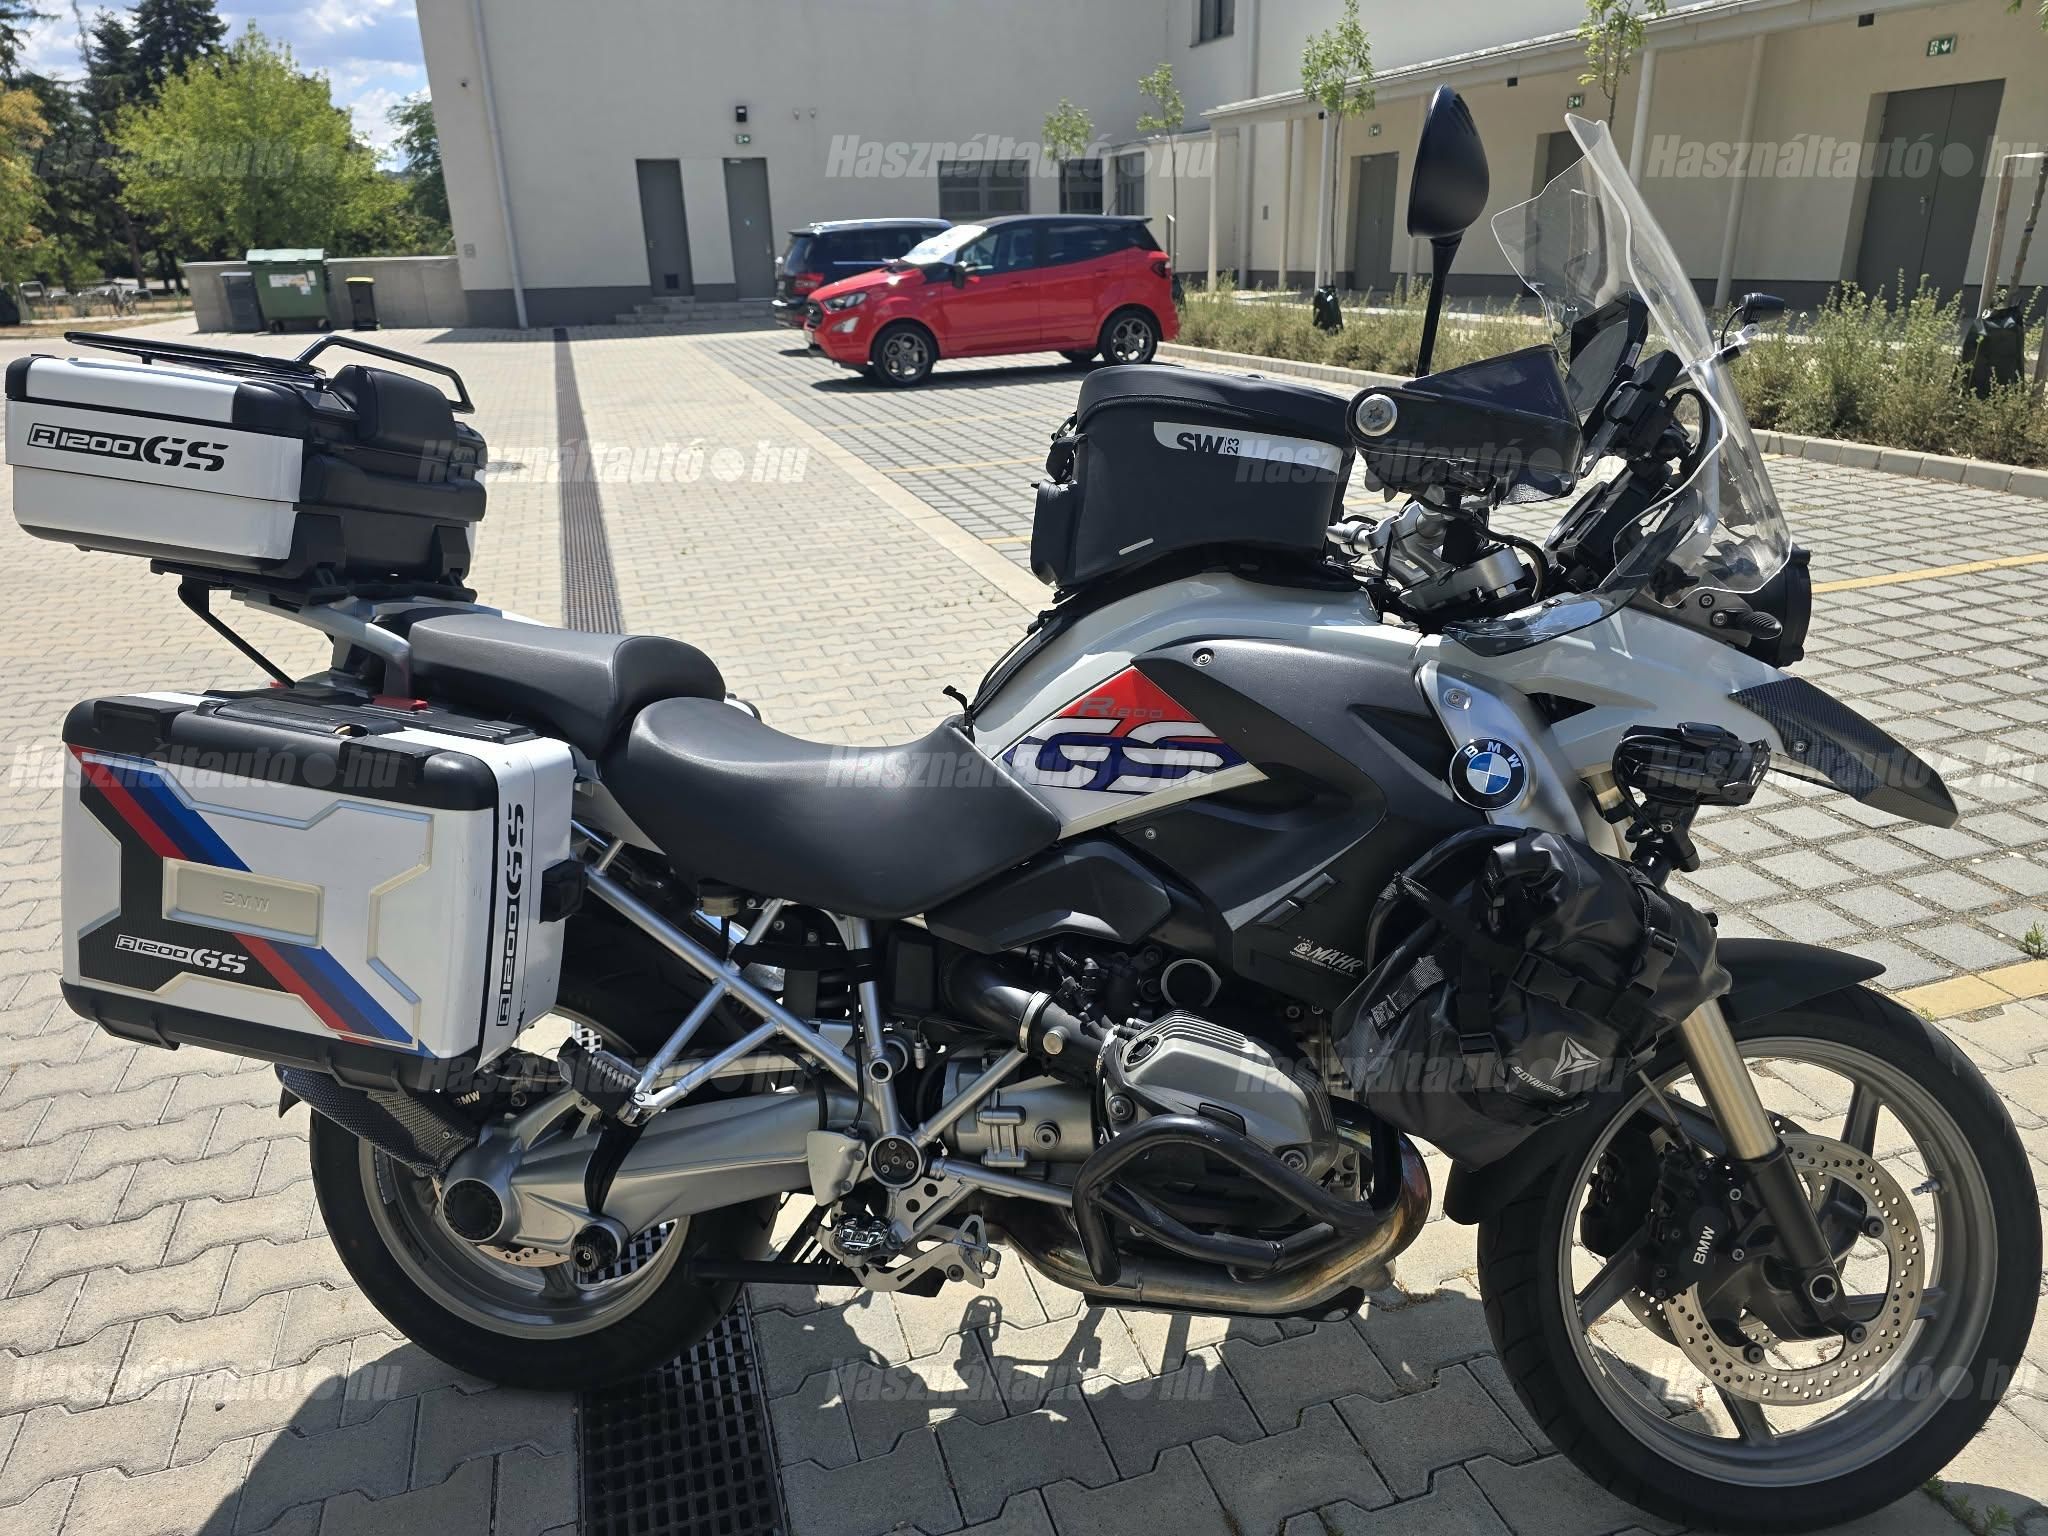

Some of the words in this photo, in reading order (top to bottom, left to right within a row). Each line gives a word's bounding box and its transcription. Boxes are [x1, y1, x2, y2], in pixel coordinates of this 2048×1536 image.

[1464, 741, 1522, 768] BMW
[222, 890, 271, 913] BMW
[1693, 1225, 1715, 1265] BMW
